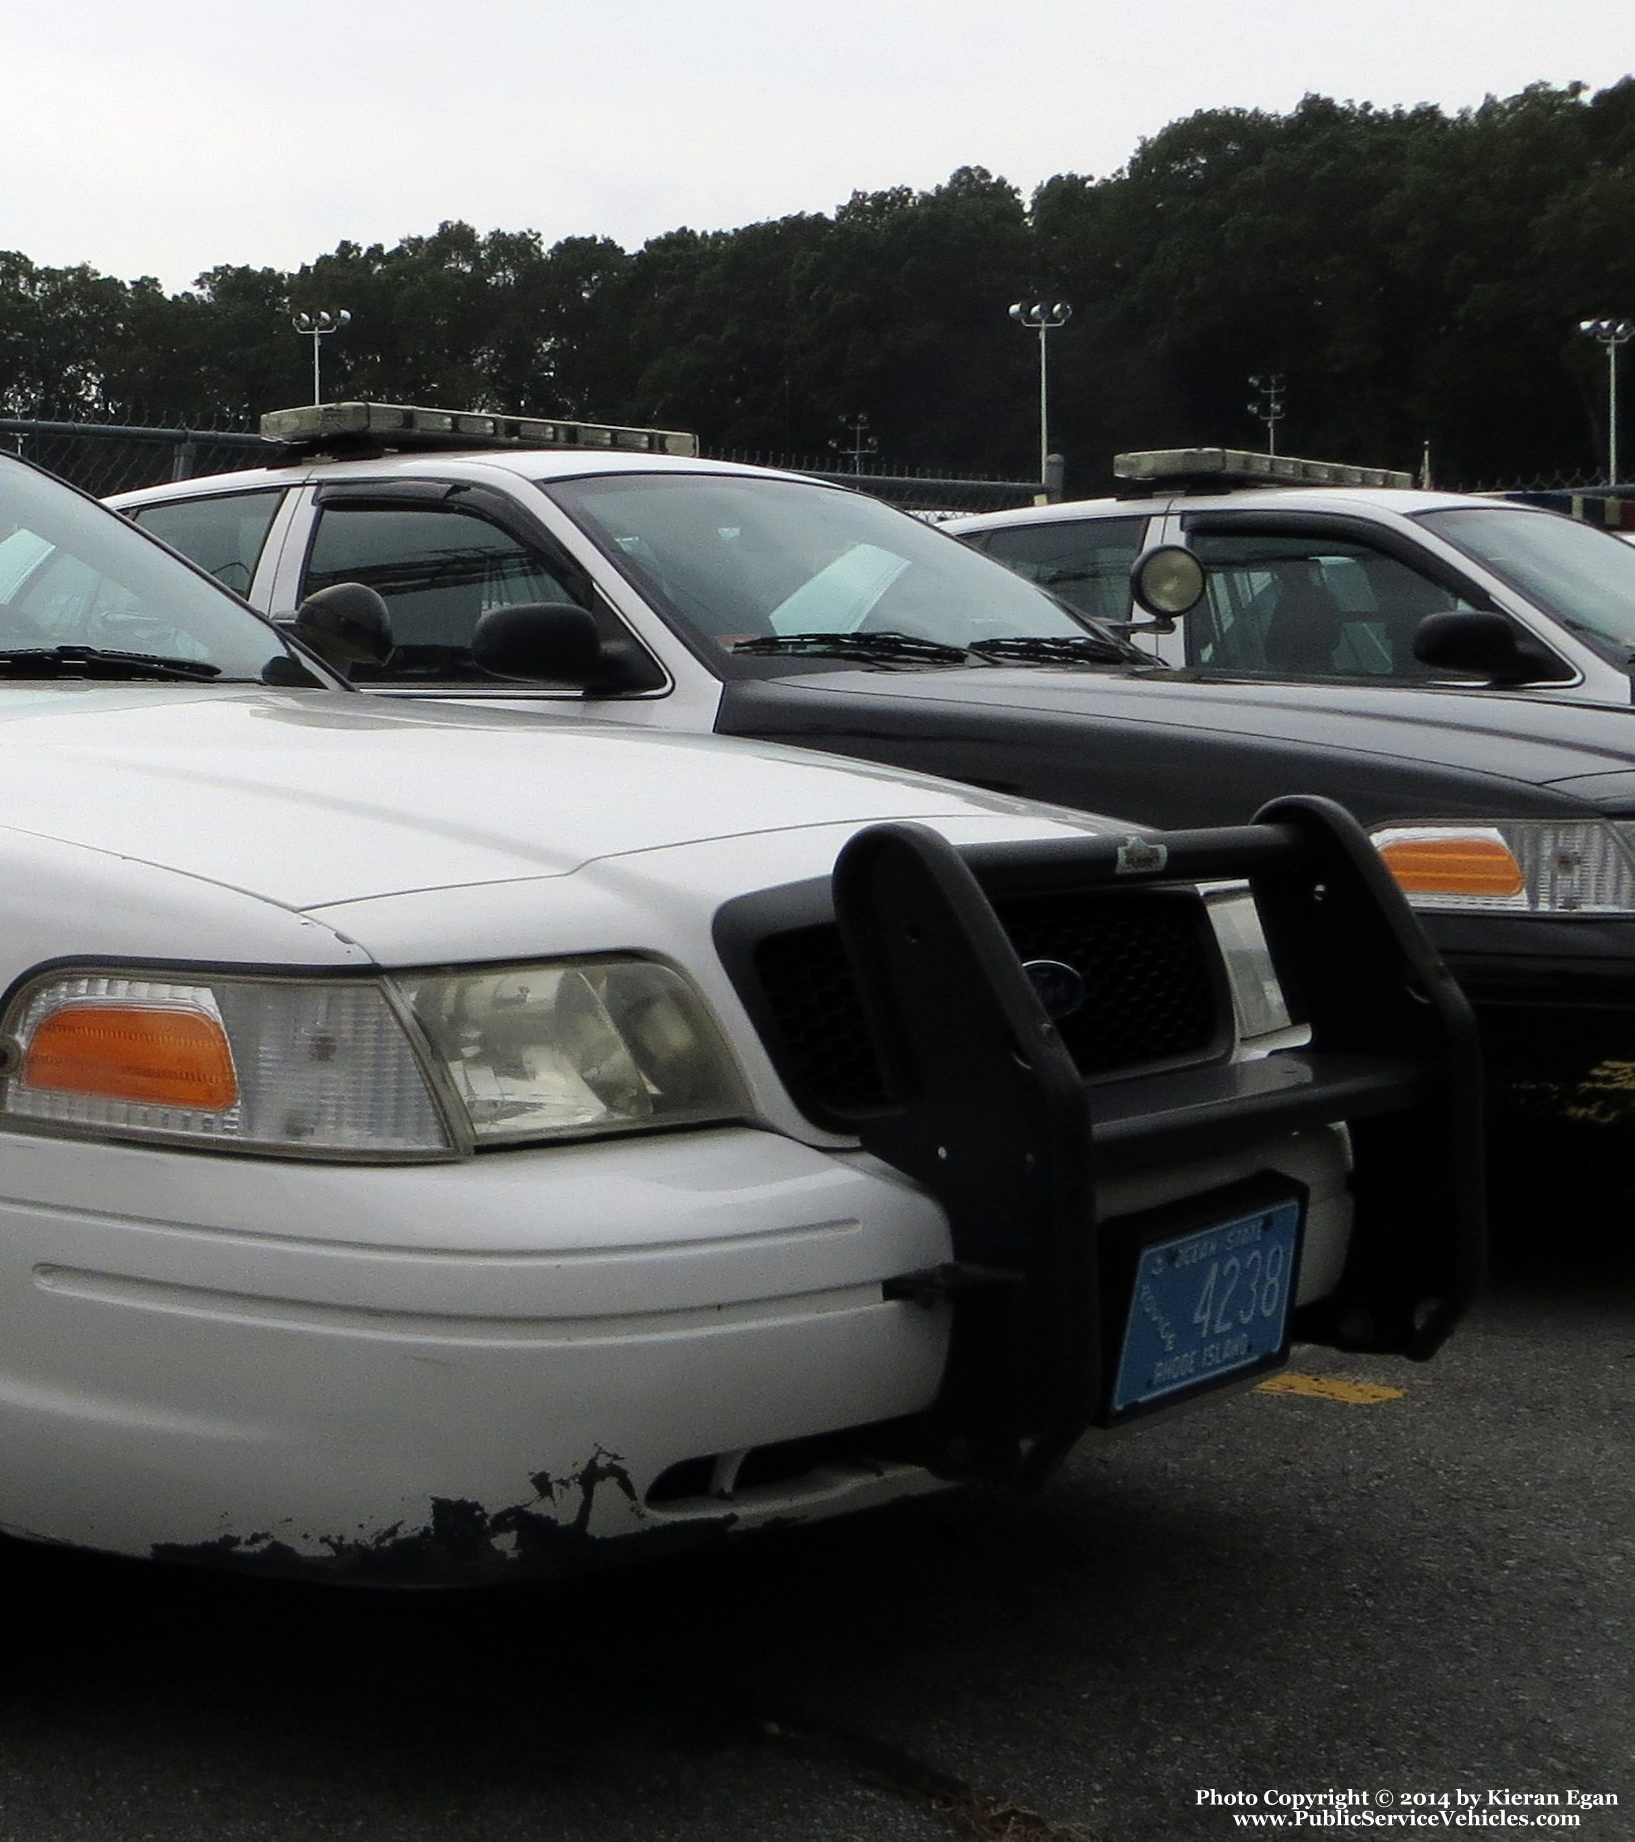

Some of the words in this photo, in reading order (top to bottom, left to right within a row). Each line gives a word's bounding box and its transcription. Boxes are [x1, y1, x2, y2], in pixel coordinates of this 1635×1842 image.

[1193, 1242, 1284, 1338] 4238
[1153, 1351, 1198, 1385] RHODE
[1201, 1333, 1249, 1368] ISLAND
